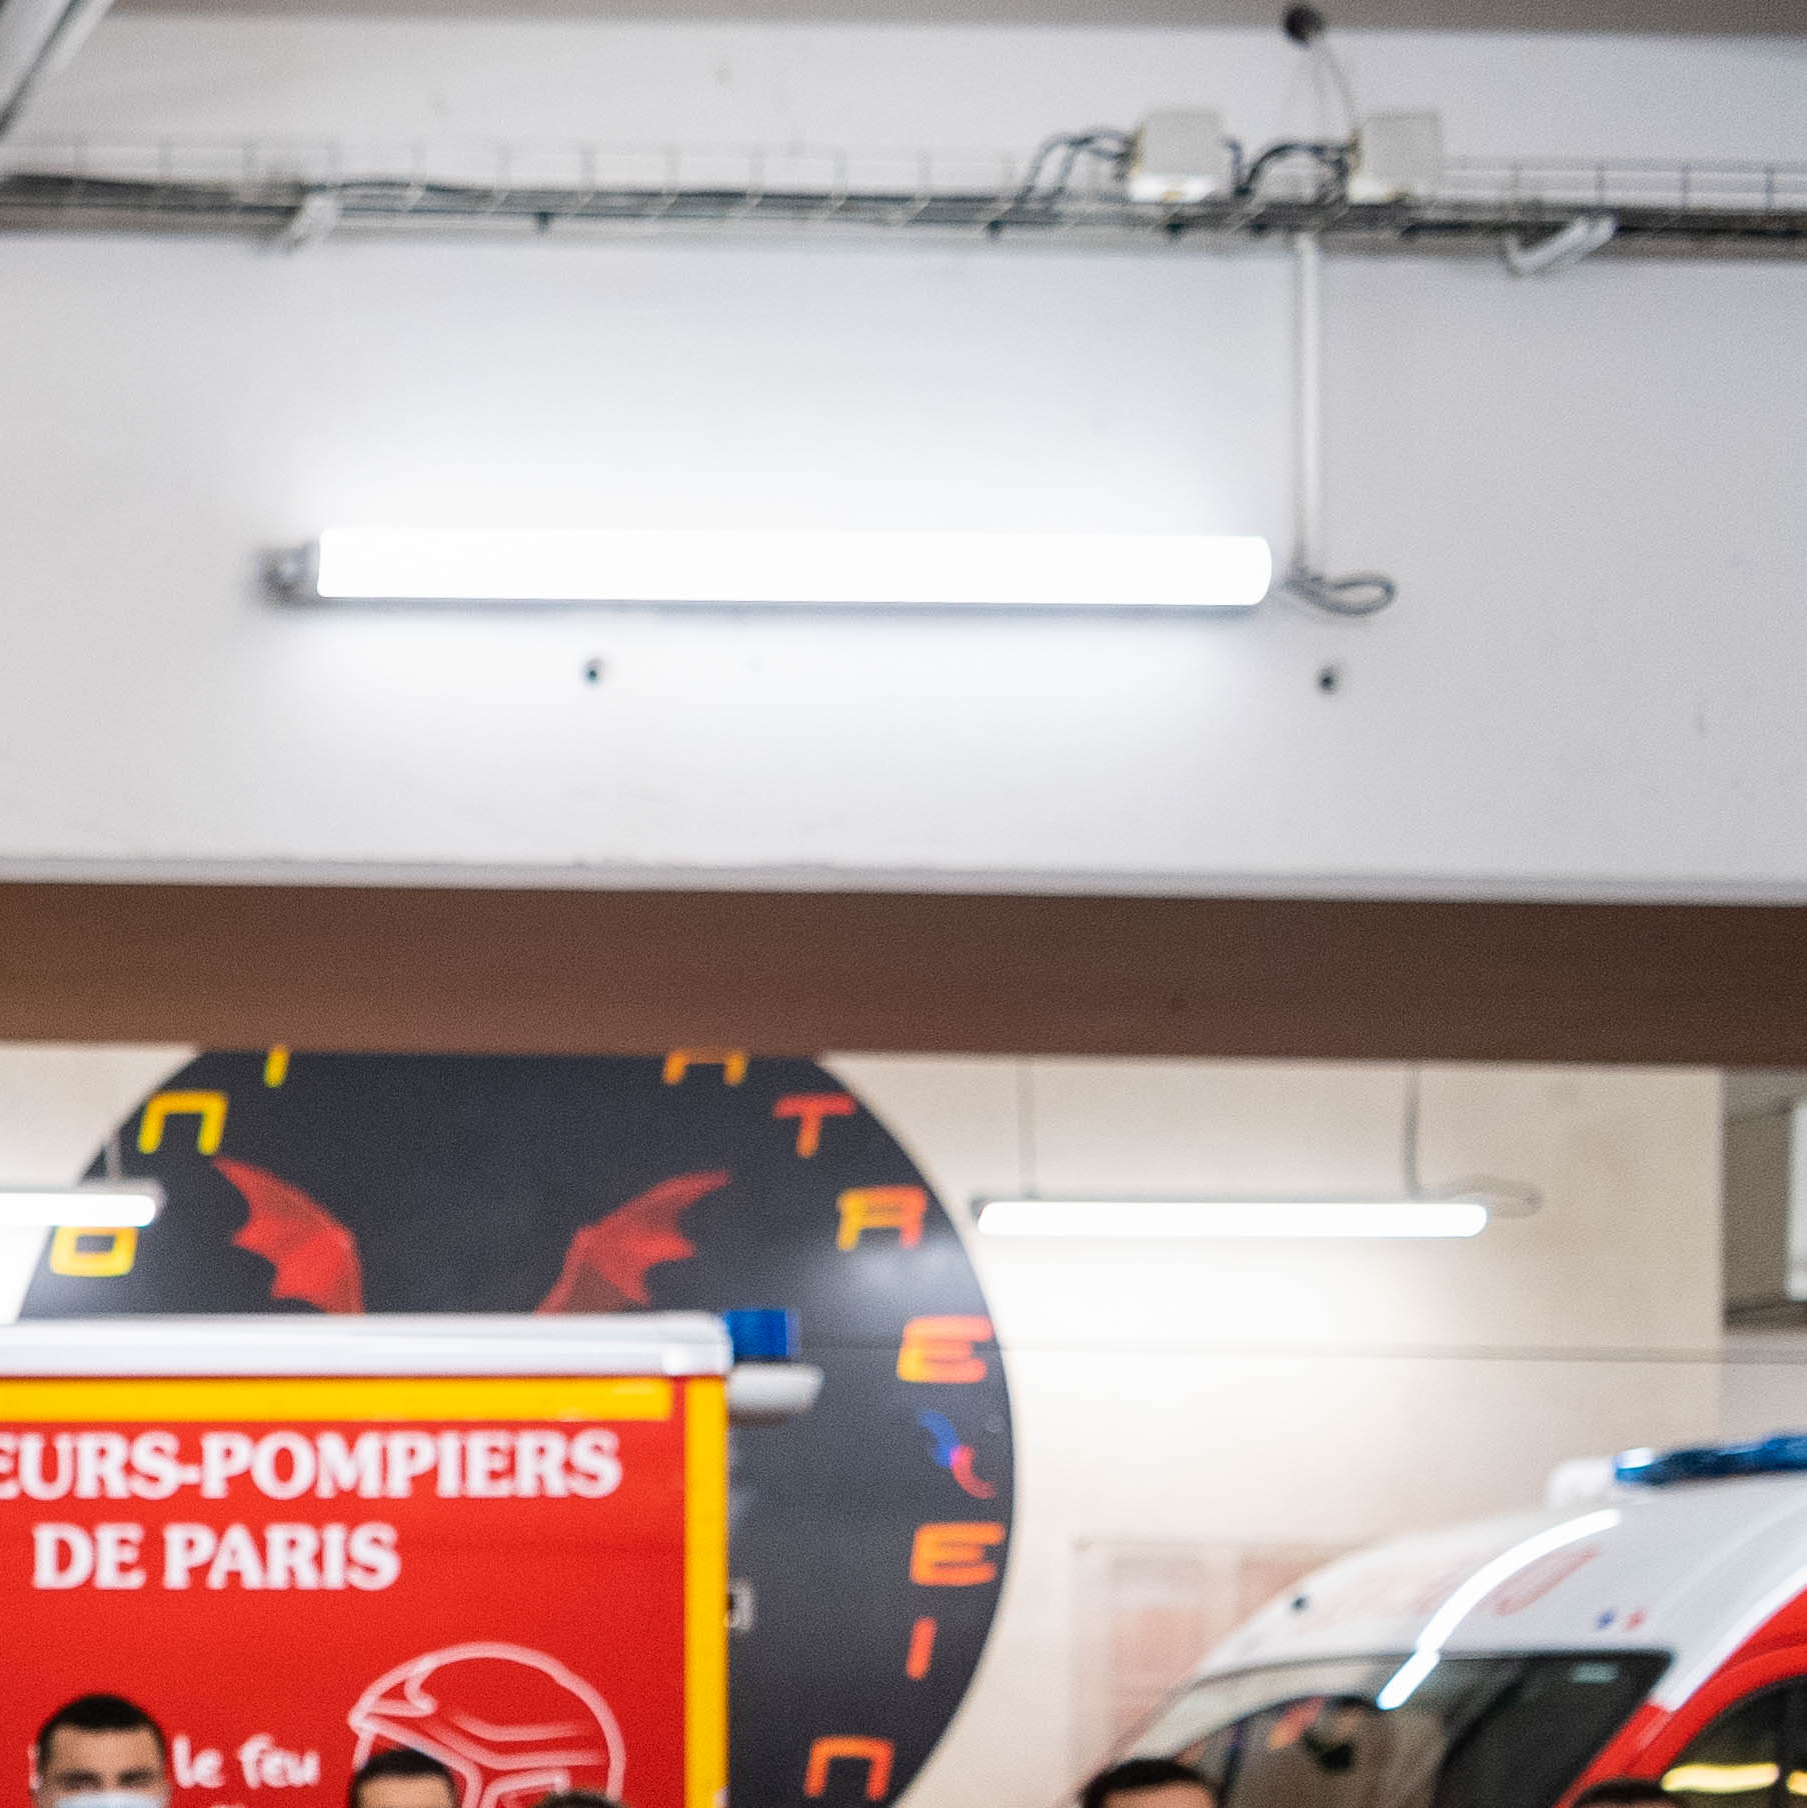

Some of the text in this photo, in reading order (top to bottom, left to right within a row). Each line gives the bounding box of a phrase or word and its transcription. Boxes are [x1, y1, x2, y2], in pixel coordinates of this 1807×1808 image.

[31, 1521, 403, 1592] DE PARIS
[171, 1734, 321, 1789] le feu
